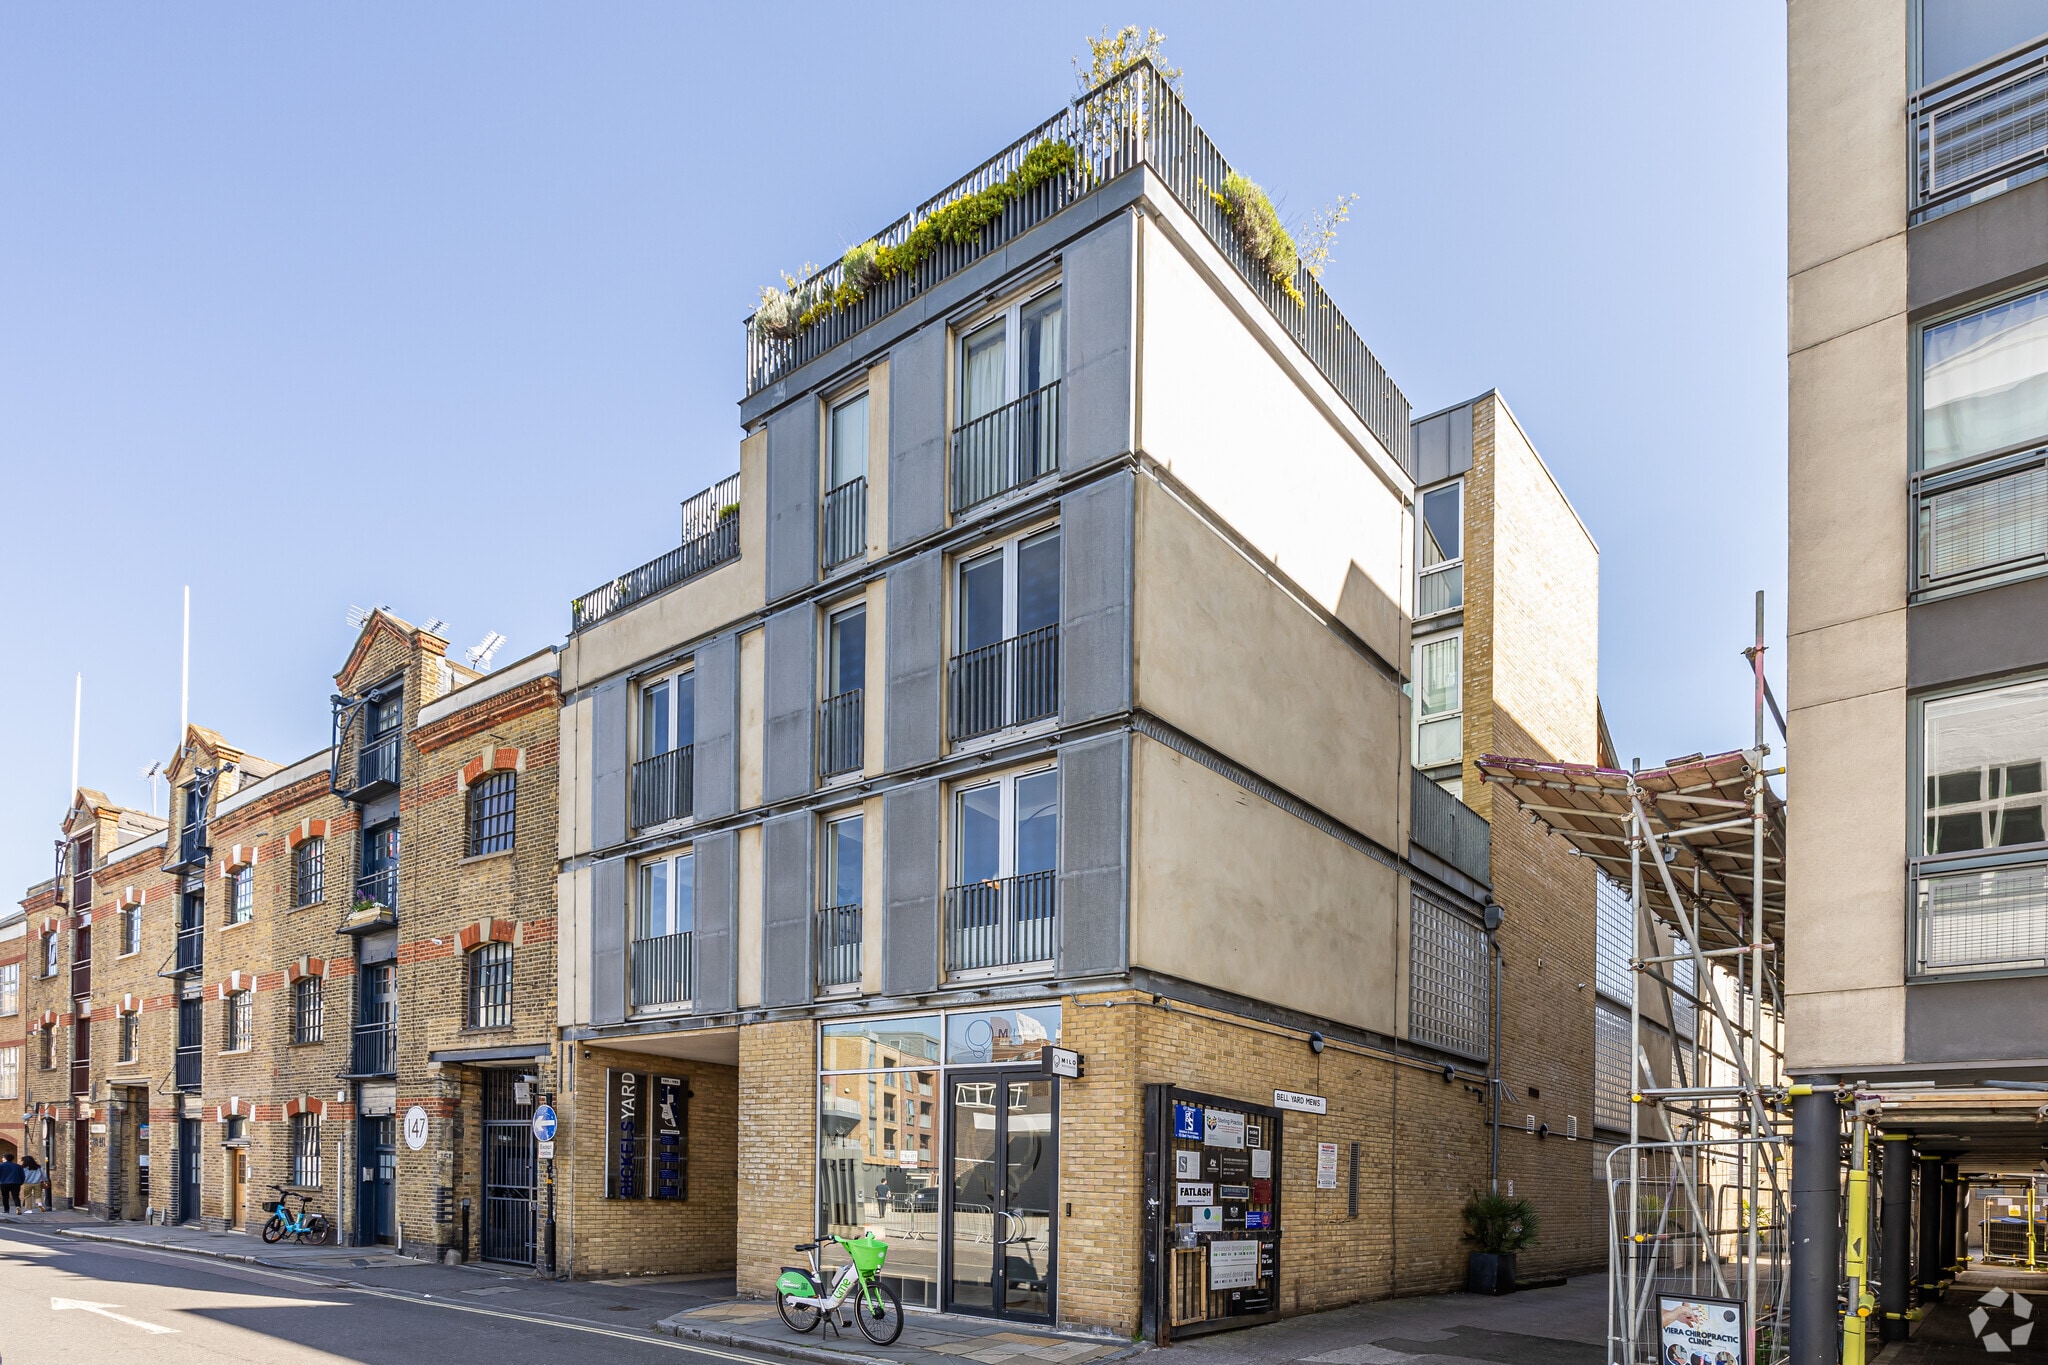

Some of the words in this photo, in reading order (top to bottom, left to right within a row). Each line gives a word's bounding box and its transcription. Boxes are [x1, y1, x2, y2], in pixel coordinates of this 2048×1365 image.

[1061, 1057, 1077, 1066] MILO
[621, 1072, 635, 1120] YARD
[1276, 1093, 1290, 1103] BELL
[1290, 1095, 1305, 1105] YARD
[1305, 1097, 1321, 1107] MEWS
[407, 1118, 426, 1139] 147
[620, 1121, 635, 1197] BICKELS
[1180, 1187, 1212, 1197] FATLASH
[1663, 1327, 1684, 1336] VIERA
[1684, 1329, 1739, 1344] CHIROPRACTIC
[1688, 1337, 1713, 1347] CLINIC
